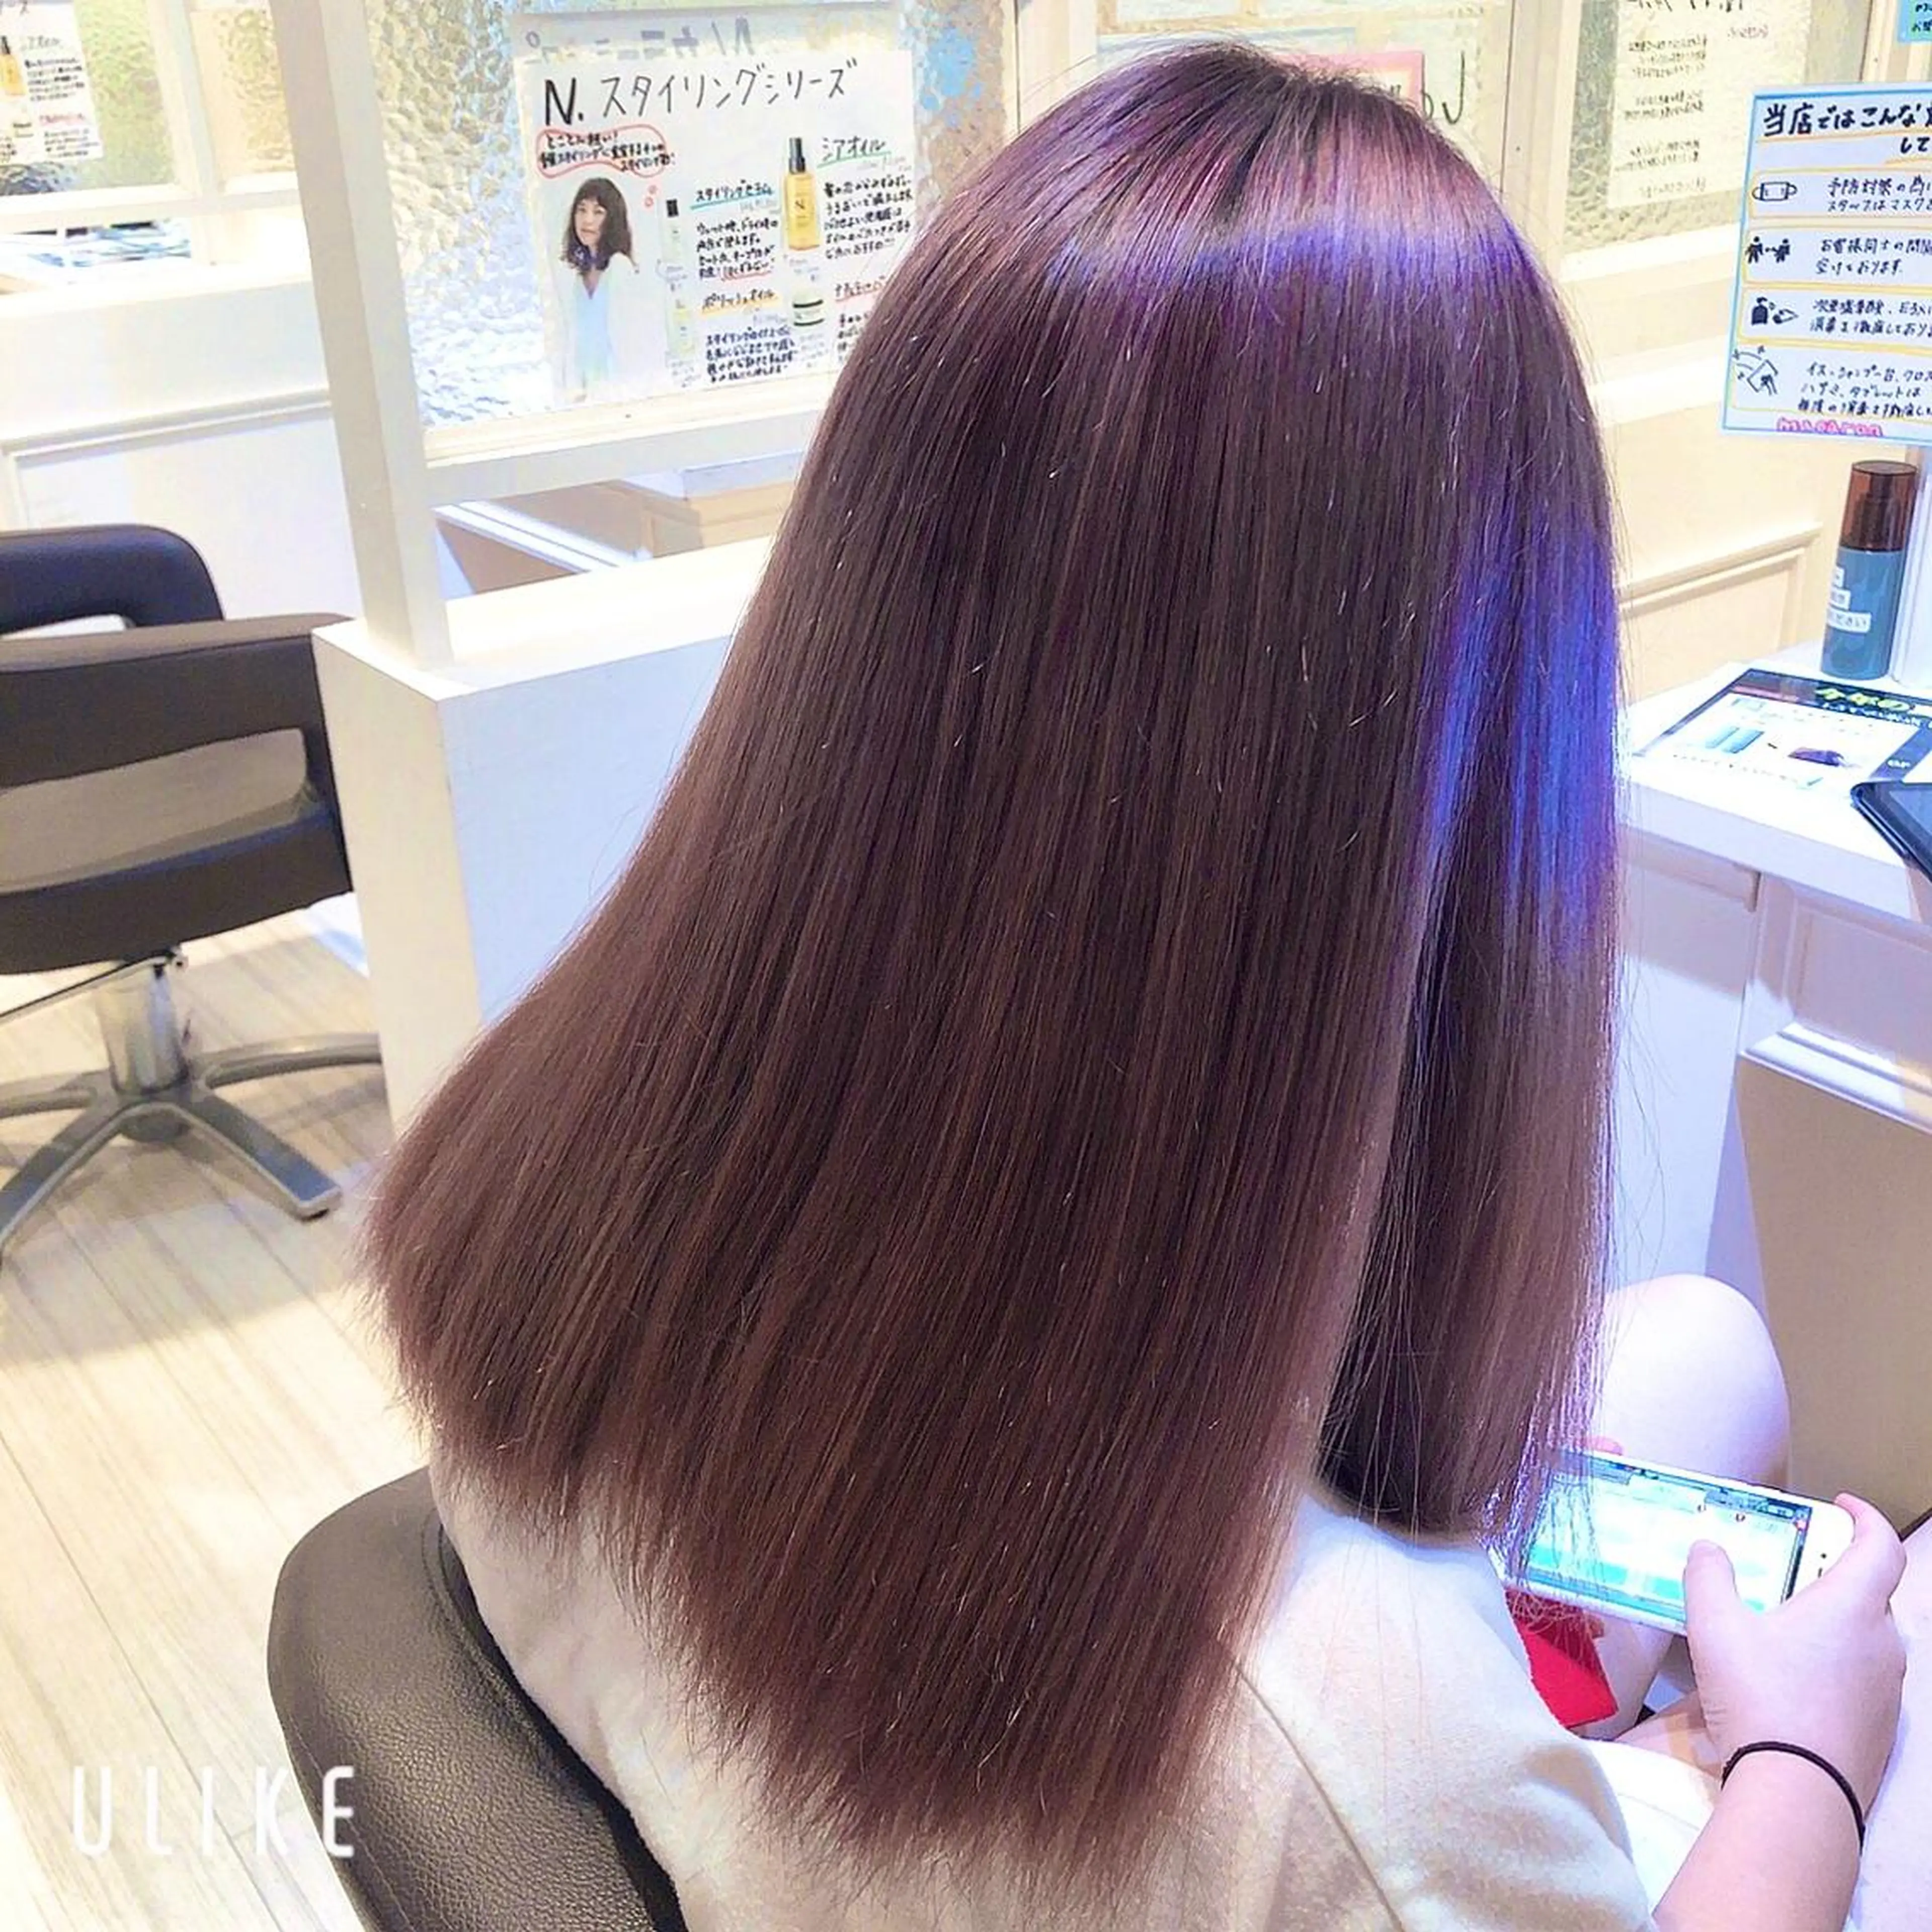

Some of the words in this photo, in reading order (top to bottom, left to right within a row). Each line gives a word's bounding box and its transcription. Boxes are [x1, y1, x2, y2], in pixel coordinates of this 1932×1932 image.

[544, 77, 584, 126] N.
[601, 57, 858, 118] スタイリングシリーズ
[1763, 102, 1932, 137] 当店ではこんな
